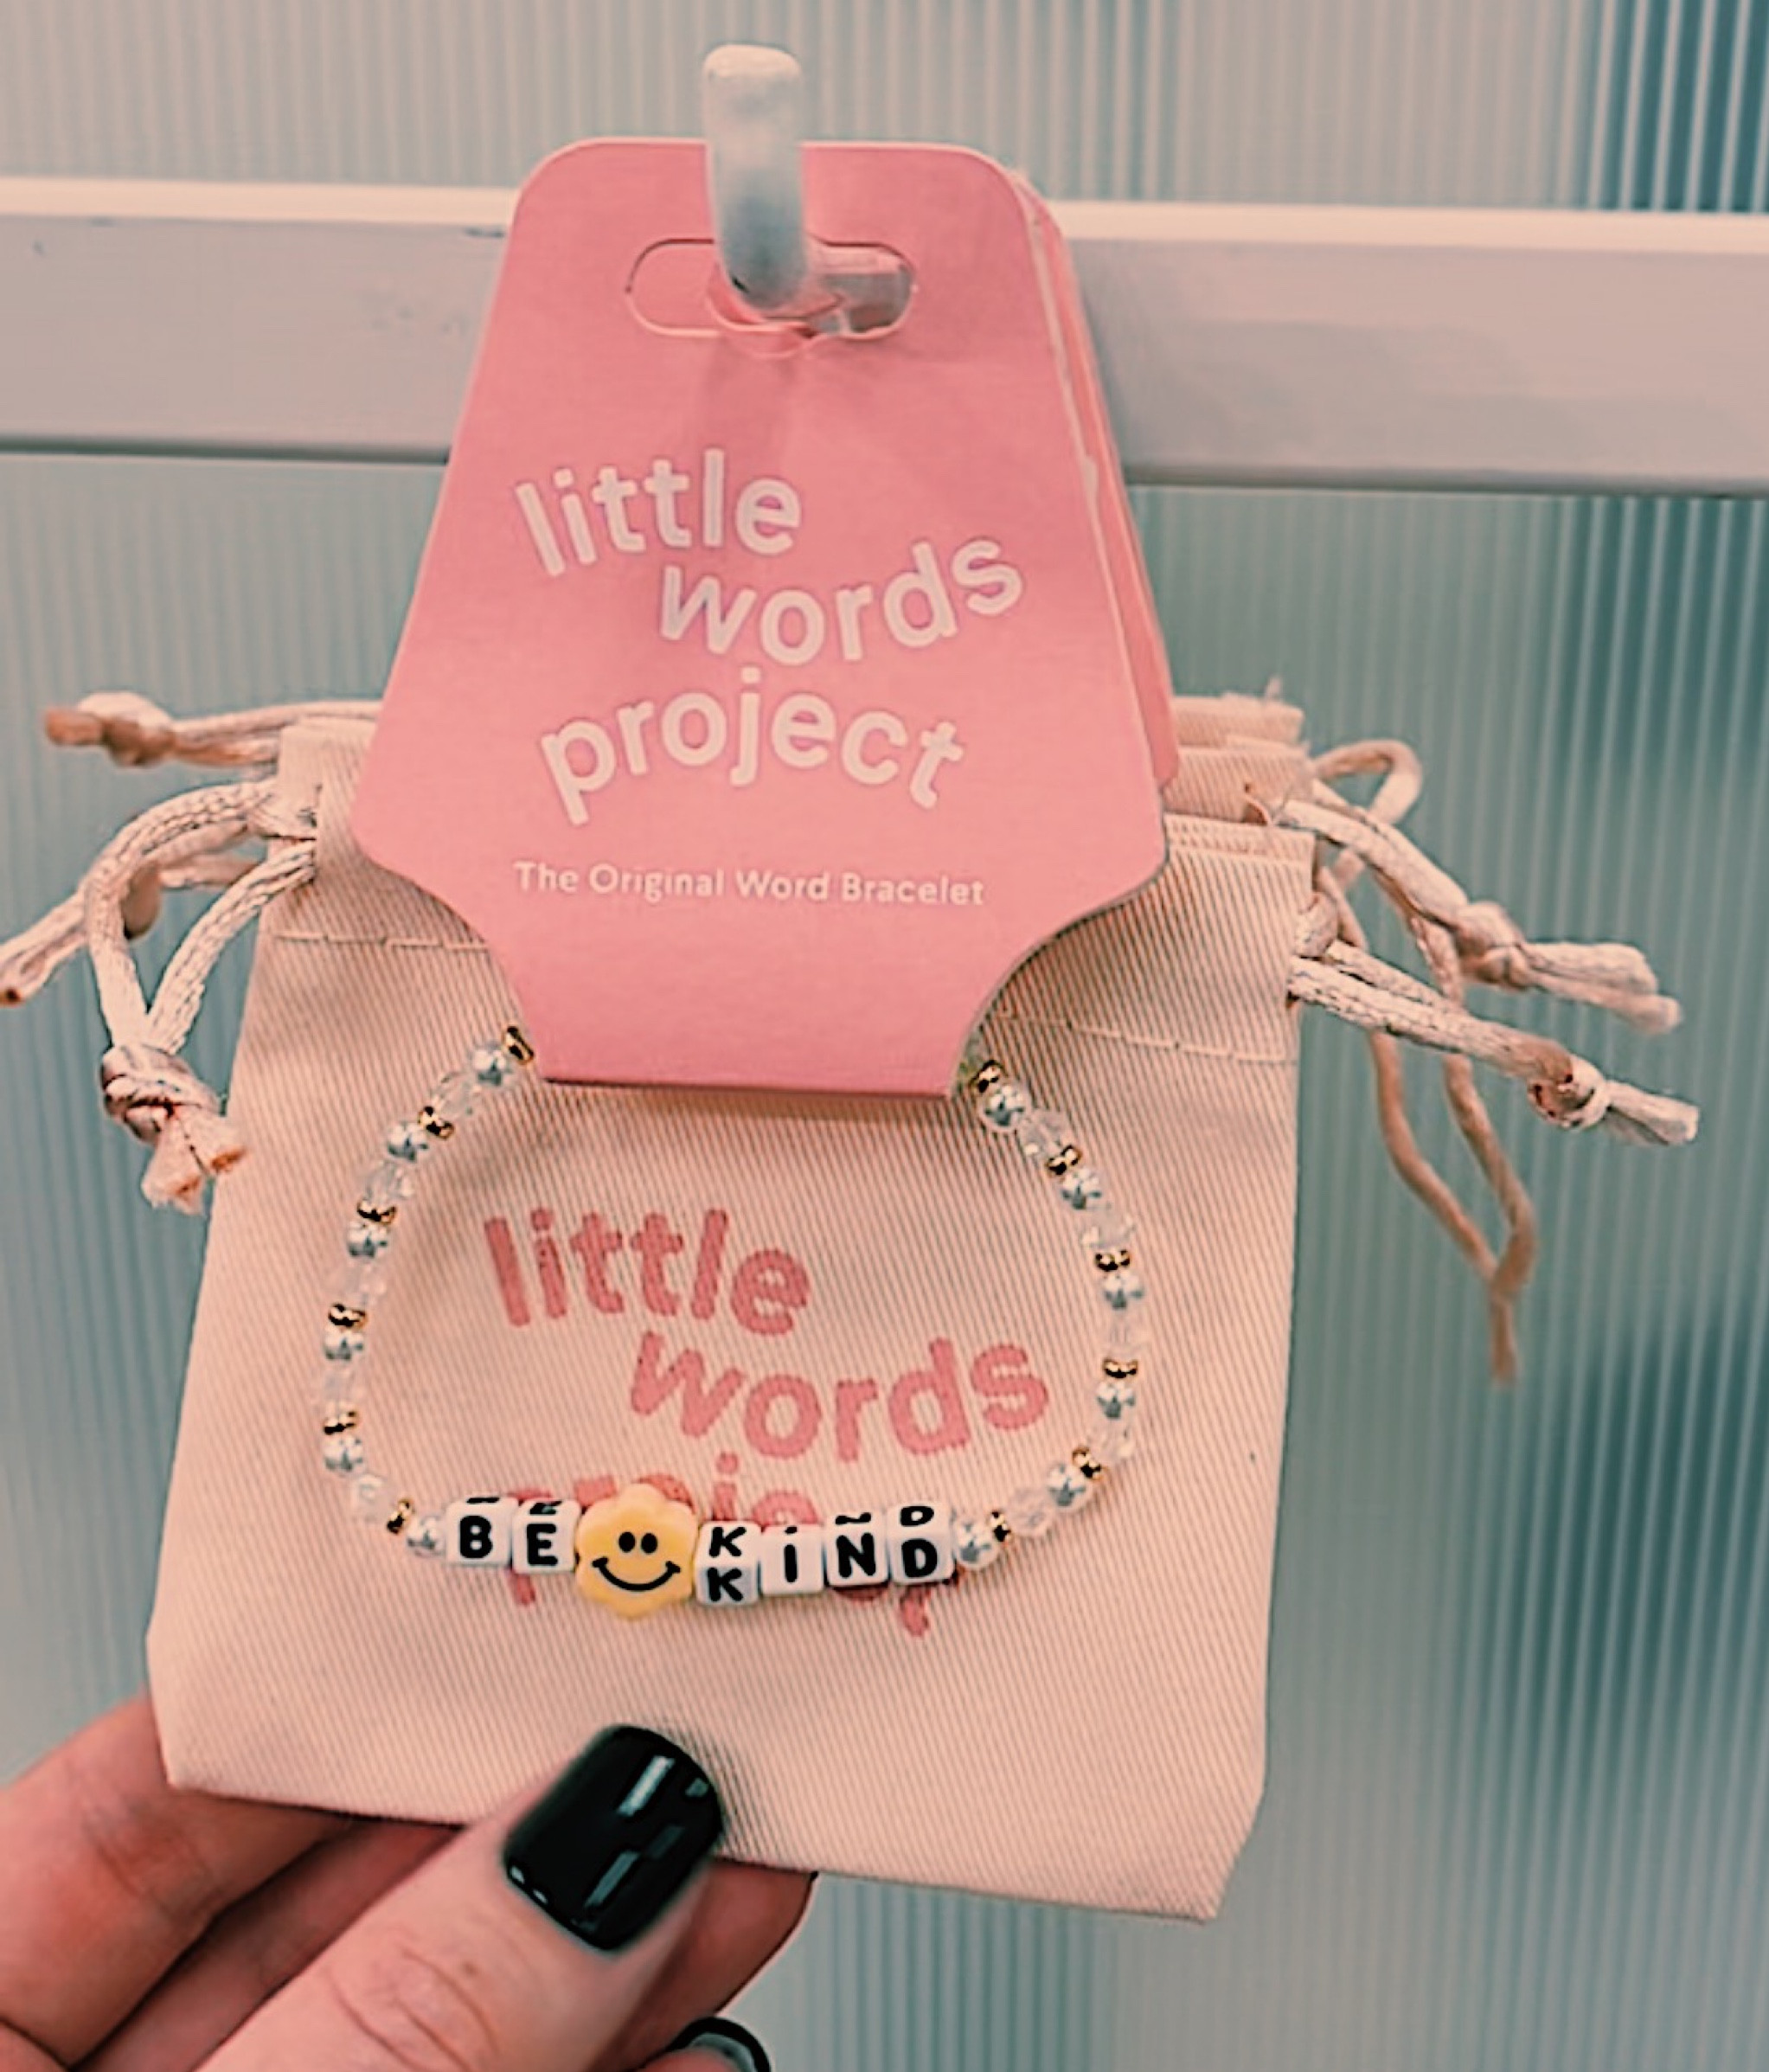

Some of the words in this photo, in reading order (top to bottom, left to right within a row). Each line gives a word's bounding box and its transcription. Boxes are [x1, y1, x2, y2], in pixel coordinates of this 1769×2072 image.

[516, 448, 802, 577] little
[660, 537, 1024, 666] words
[541, 665, 965, 825] project
[514, 861, 578, 893] The
[589, 863, 726, 903] Original
[736, 869, 830, 901] Word
[842, 872, 985, 907] Bracelet
[484, 1208, 811, 1336] little
[629, 1330, 1049, 1462] words
[458, 1514, 559, 1567] BE
[707, 1532, 939, 1602] KIND
